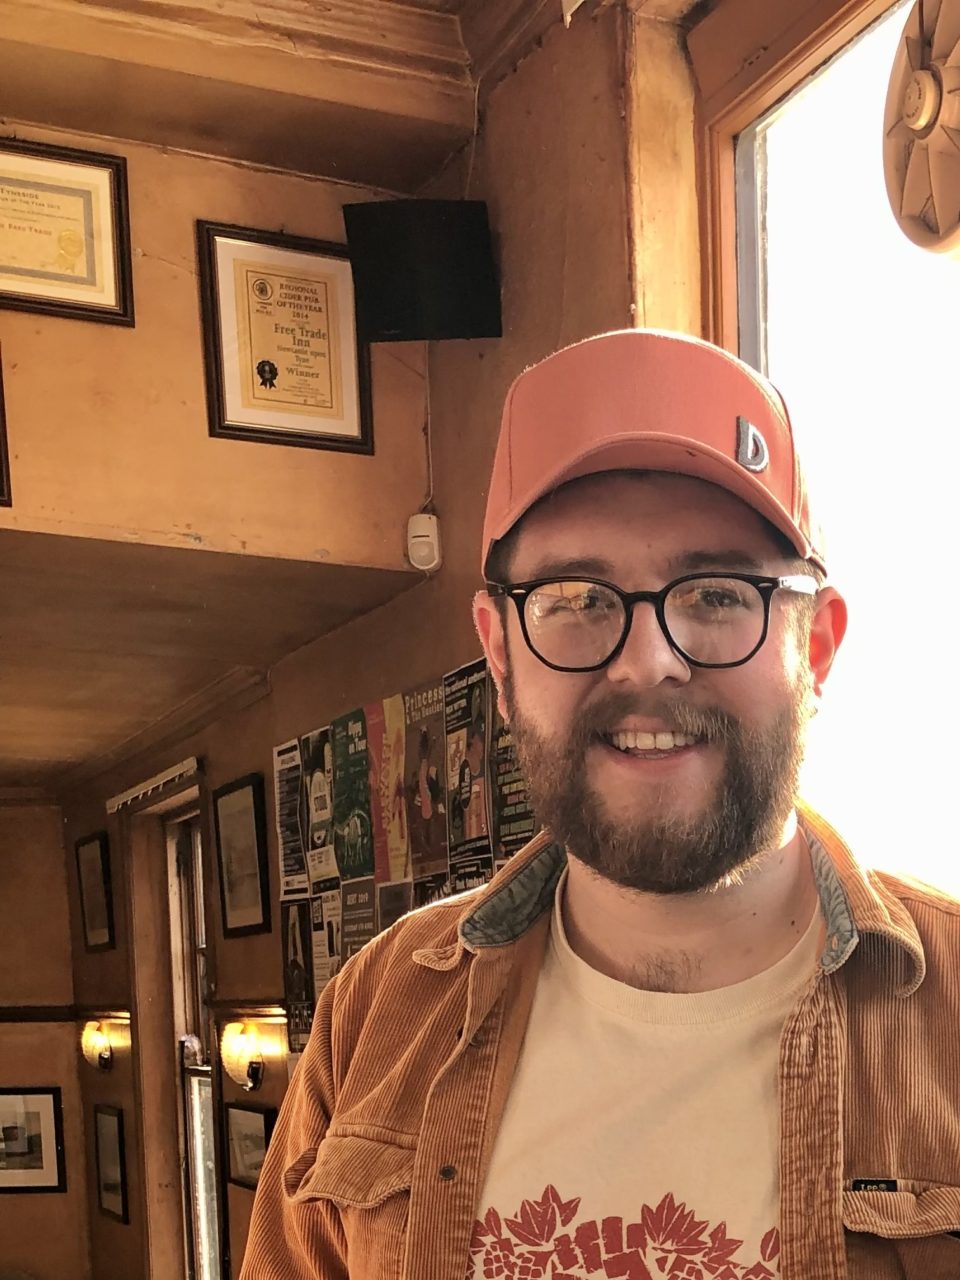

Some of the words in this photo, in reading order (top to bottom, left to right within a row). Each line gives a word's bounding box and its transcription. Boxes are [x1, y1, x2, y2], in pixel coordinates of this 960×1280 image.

[279, 283, 319, 295] REGIONAL
[279, 293, 303, 302] CIDER
[304, 295, 320, 304] PUB
[276, 300, 287, 308] OF
[304, 303, 323, 313] YEAR
[274, 323, 296, 336] Free
[298, 327, 328, 340] Trade
[292, 335, 311, 348] Inn
[286, 367, 320, 379] Winner
[736, 415, 769, 474] D
[405, 686, 443, 713] Princess
